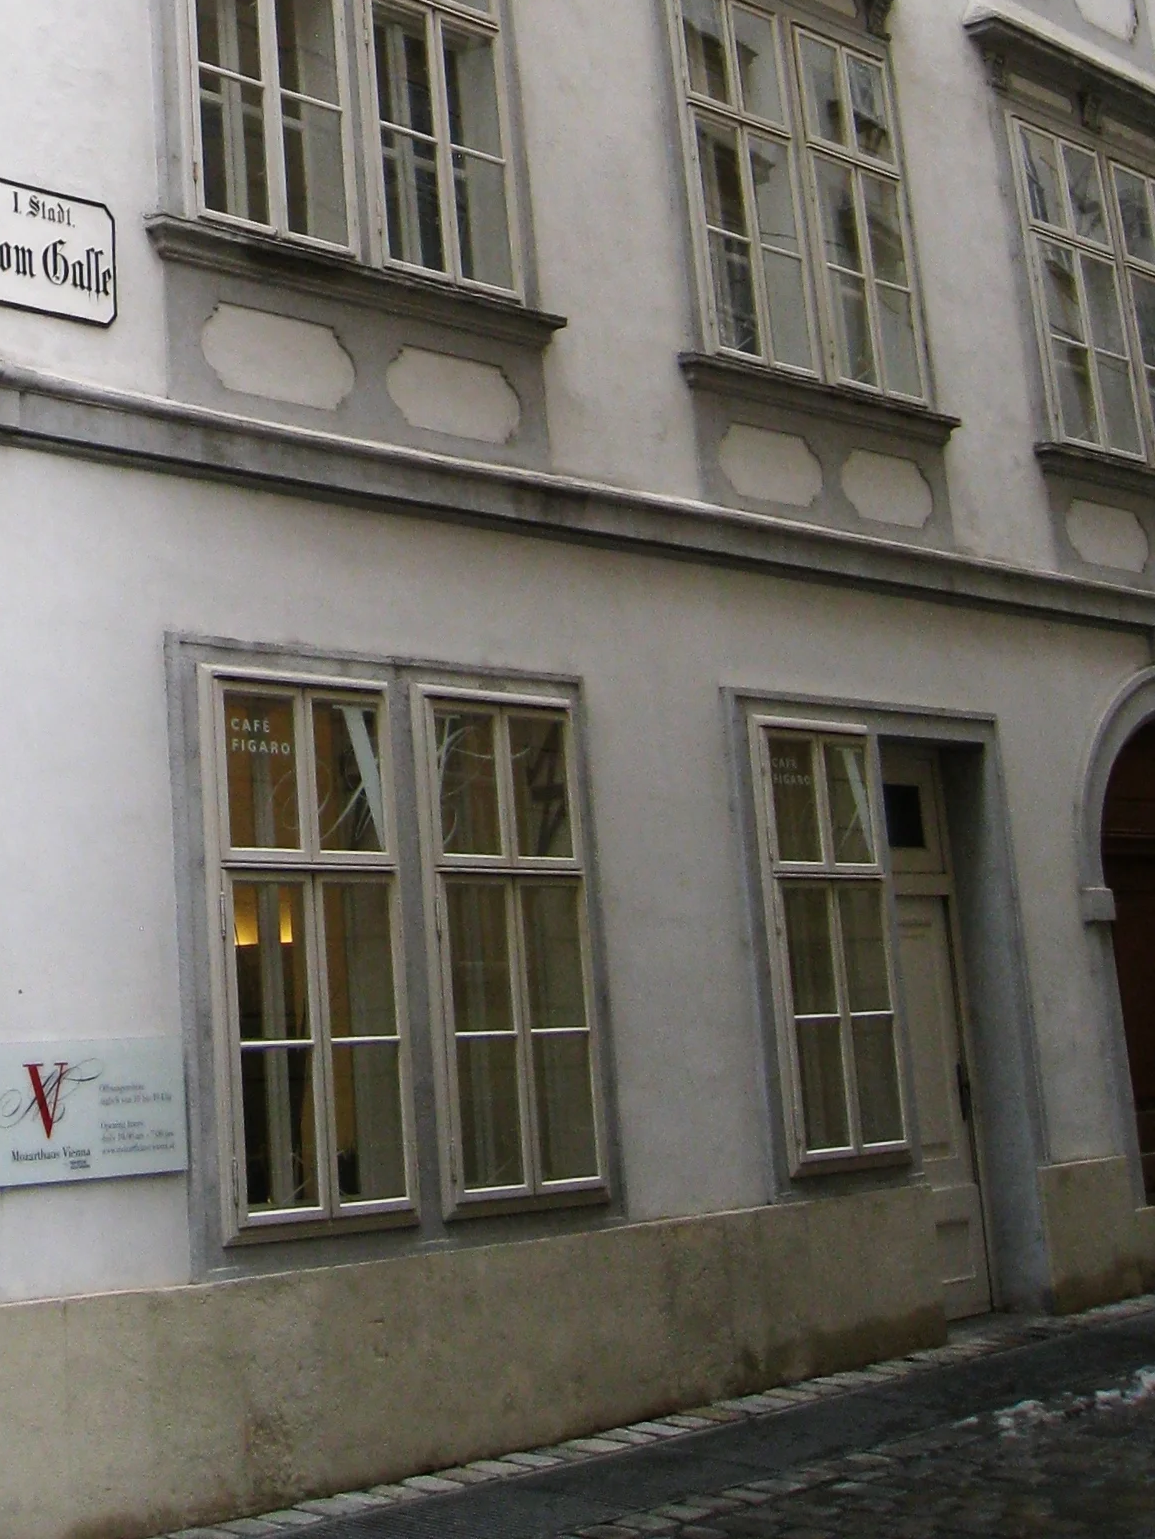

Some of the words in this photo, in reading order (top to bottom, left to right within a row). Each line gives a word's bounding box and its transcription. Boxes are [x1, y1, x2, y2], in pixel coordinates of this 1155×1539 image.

[231, 738, 291, 755] FIGARO
[11, 1148, 60, 1162] Mozarthaus
[62, 1146, 91, 1158] Vienna
